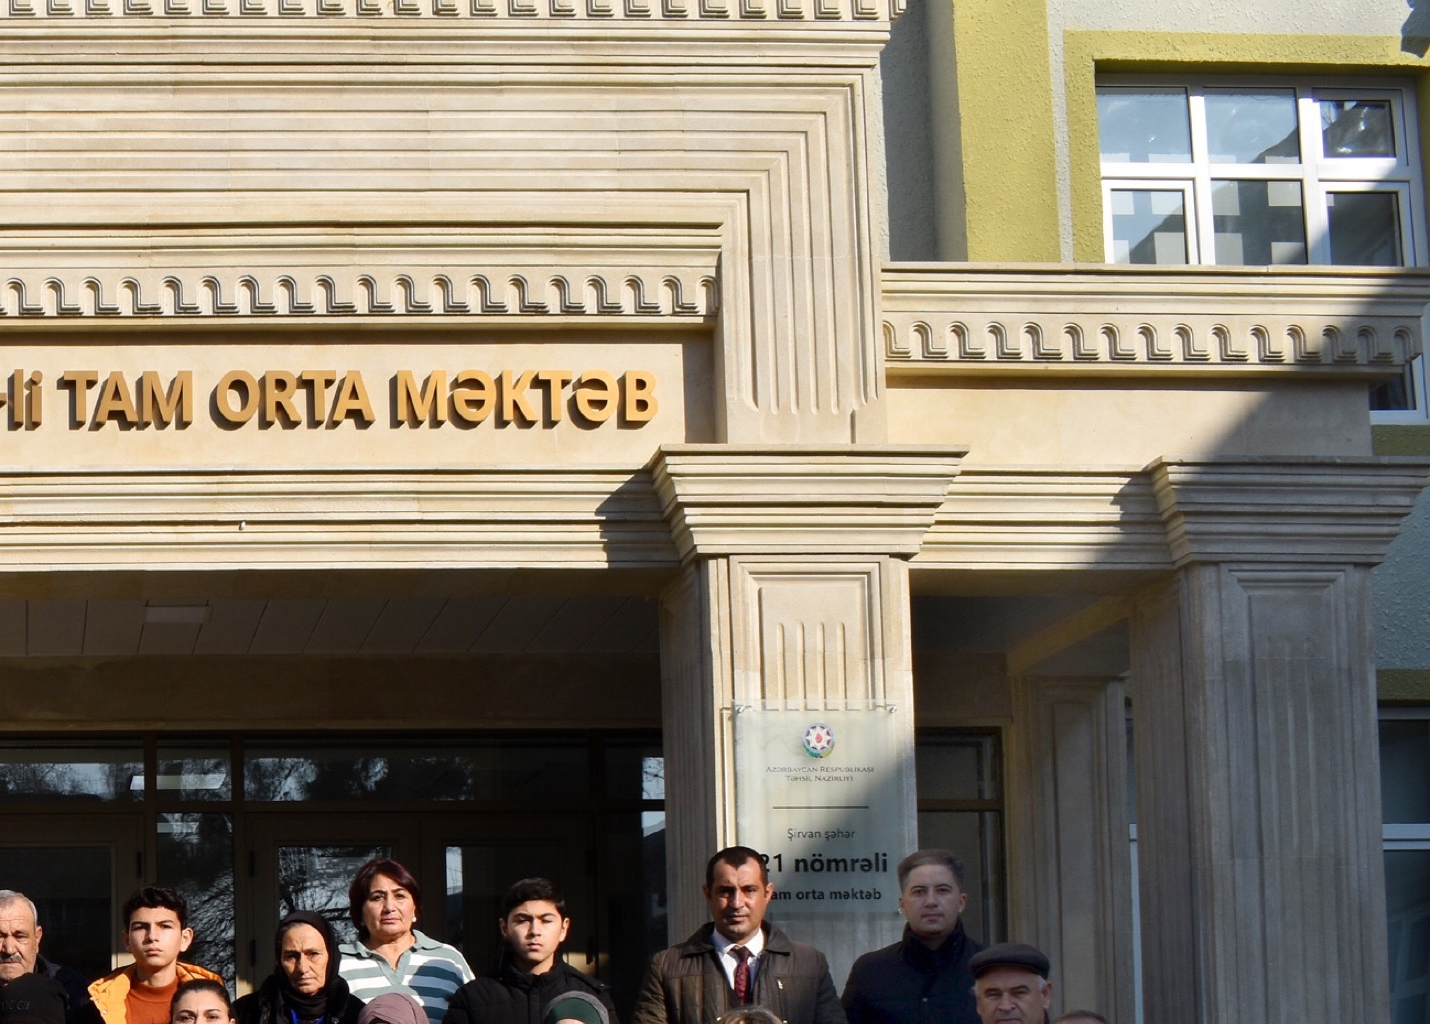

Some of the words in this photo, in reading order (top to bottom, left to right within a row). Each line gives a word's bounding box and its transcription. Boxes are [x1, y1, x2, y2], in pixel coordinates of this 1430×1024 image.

[57, 369, 194, 431] TAM
[210, 369, 376, 430] ORTA
[390, 368, 660, 430] MƏKTƏB
[787, 828, 822, 841] Şirvan
[794, 852, 888, 873] nömrəli
[771, 890, 792, 900] am
[795, 889, 825, 900] orta
[829, 887, 882, 901] məktəb
